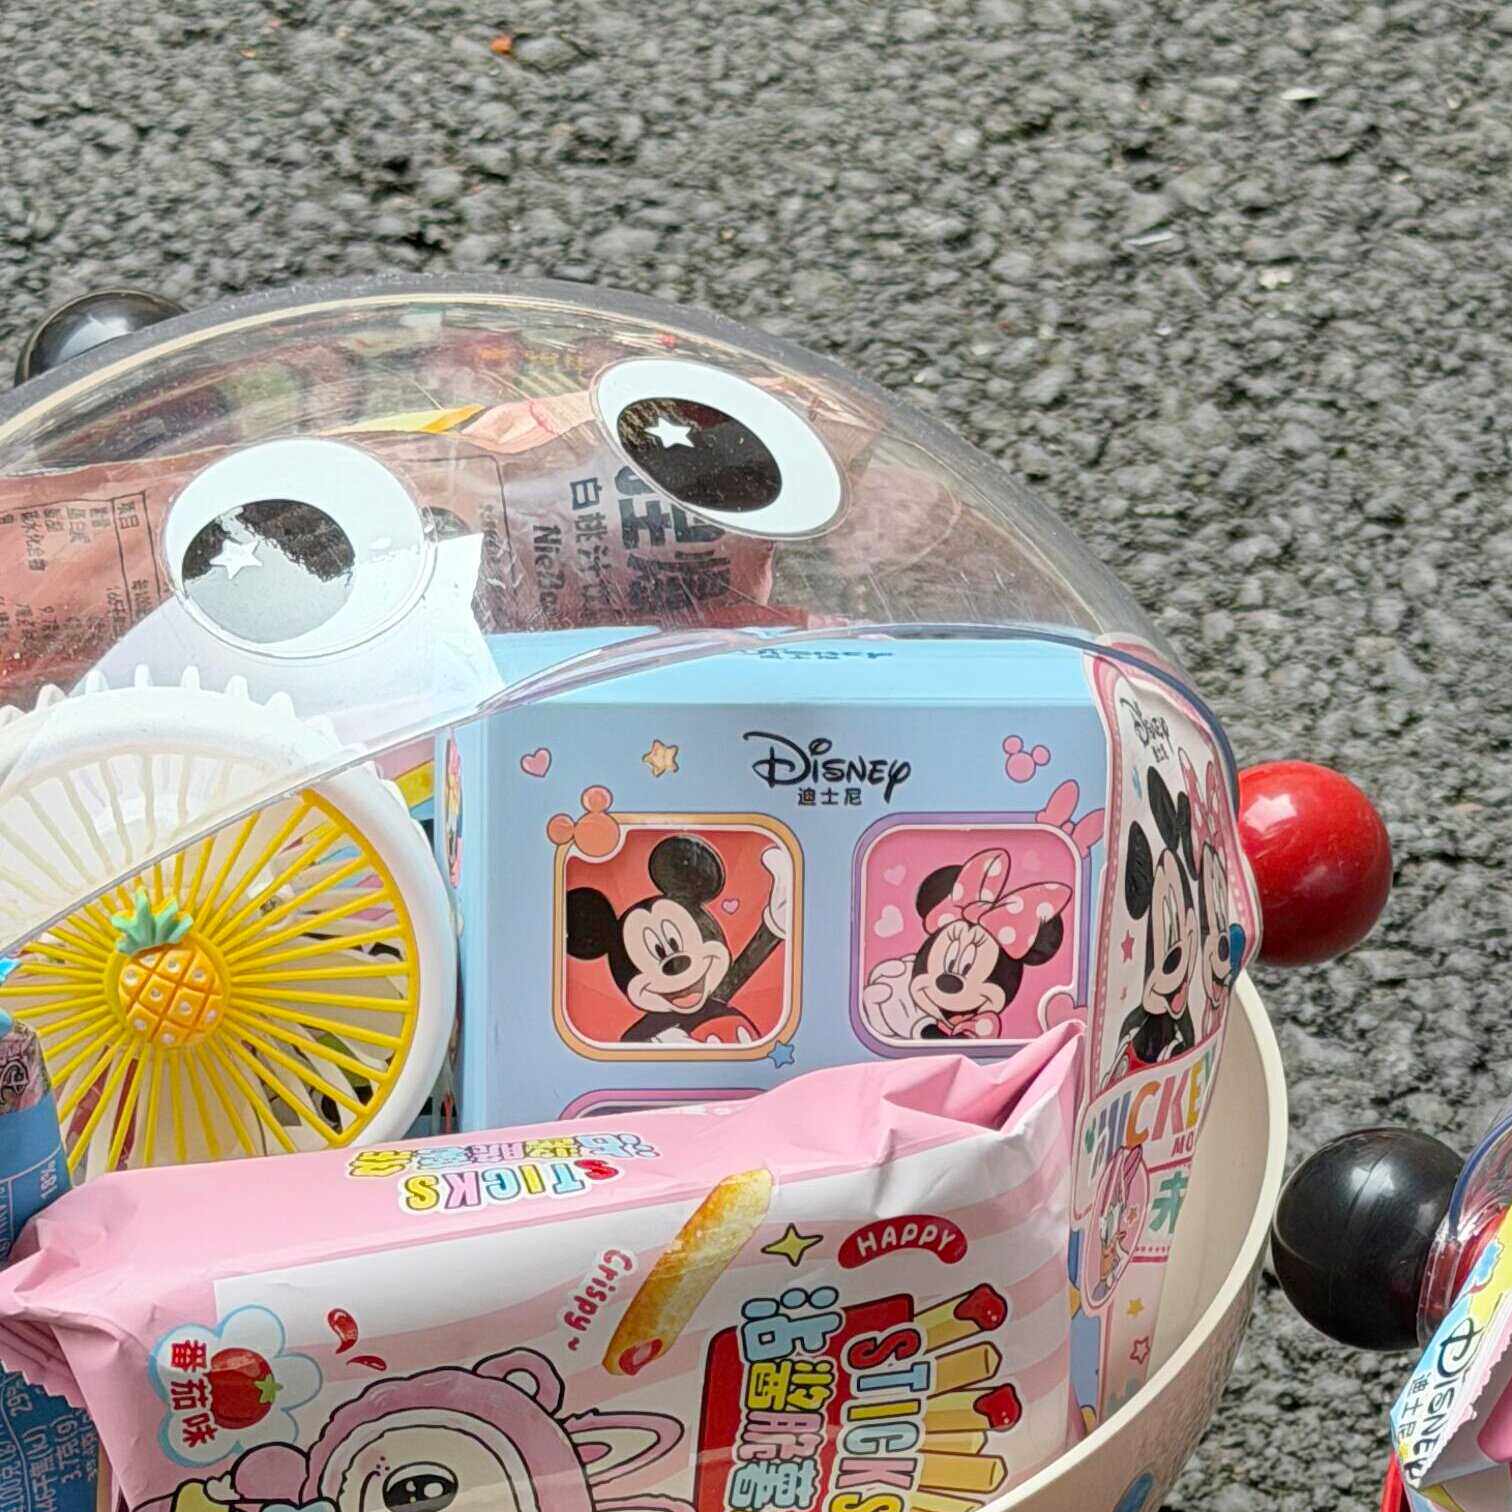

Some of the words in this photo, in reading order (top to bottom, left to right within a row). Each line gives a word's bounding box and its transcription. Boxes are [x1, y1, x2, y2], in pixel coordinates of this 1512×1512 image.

[798, 787, 863, 806] 迪士尼
[405, 1158, 620, 1213] STICKS
[856, 1224, 957, 1257] HAPPY
[169, 1339, 217, 1448] 番茄味
